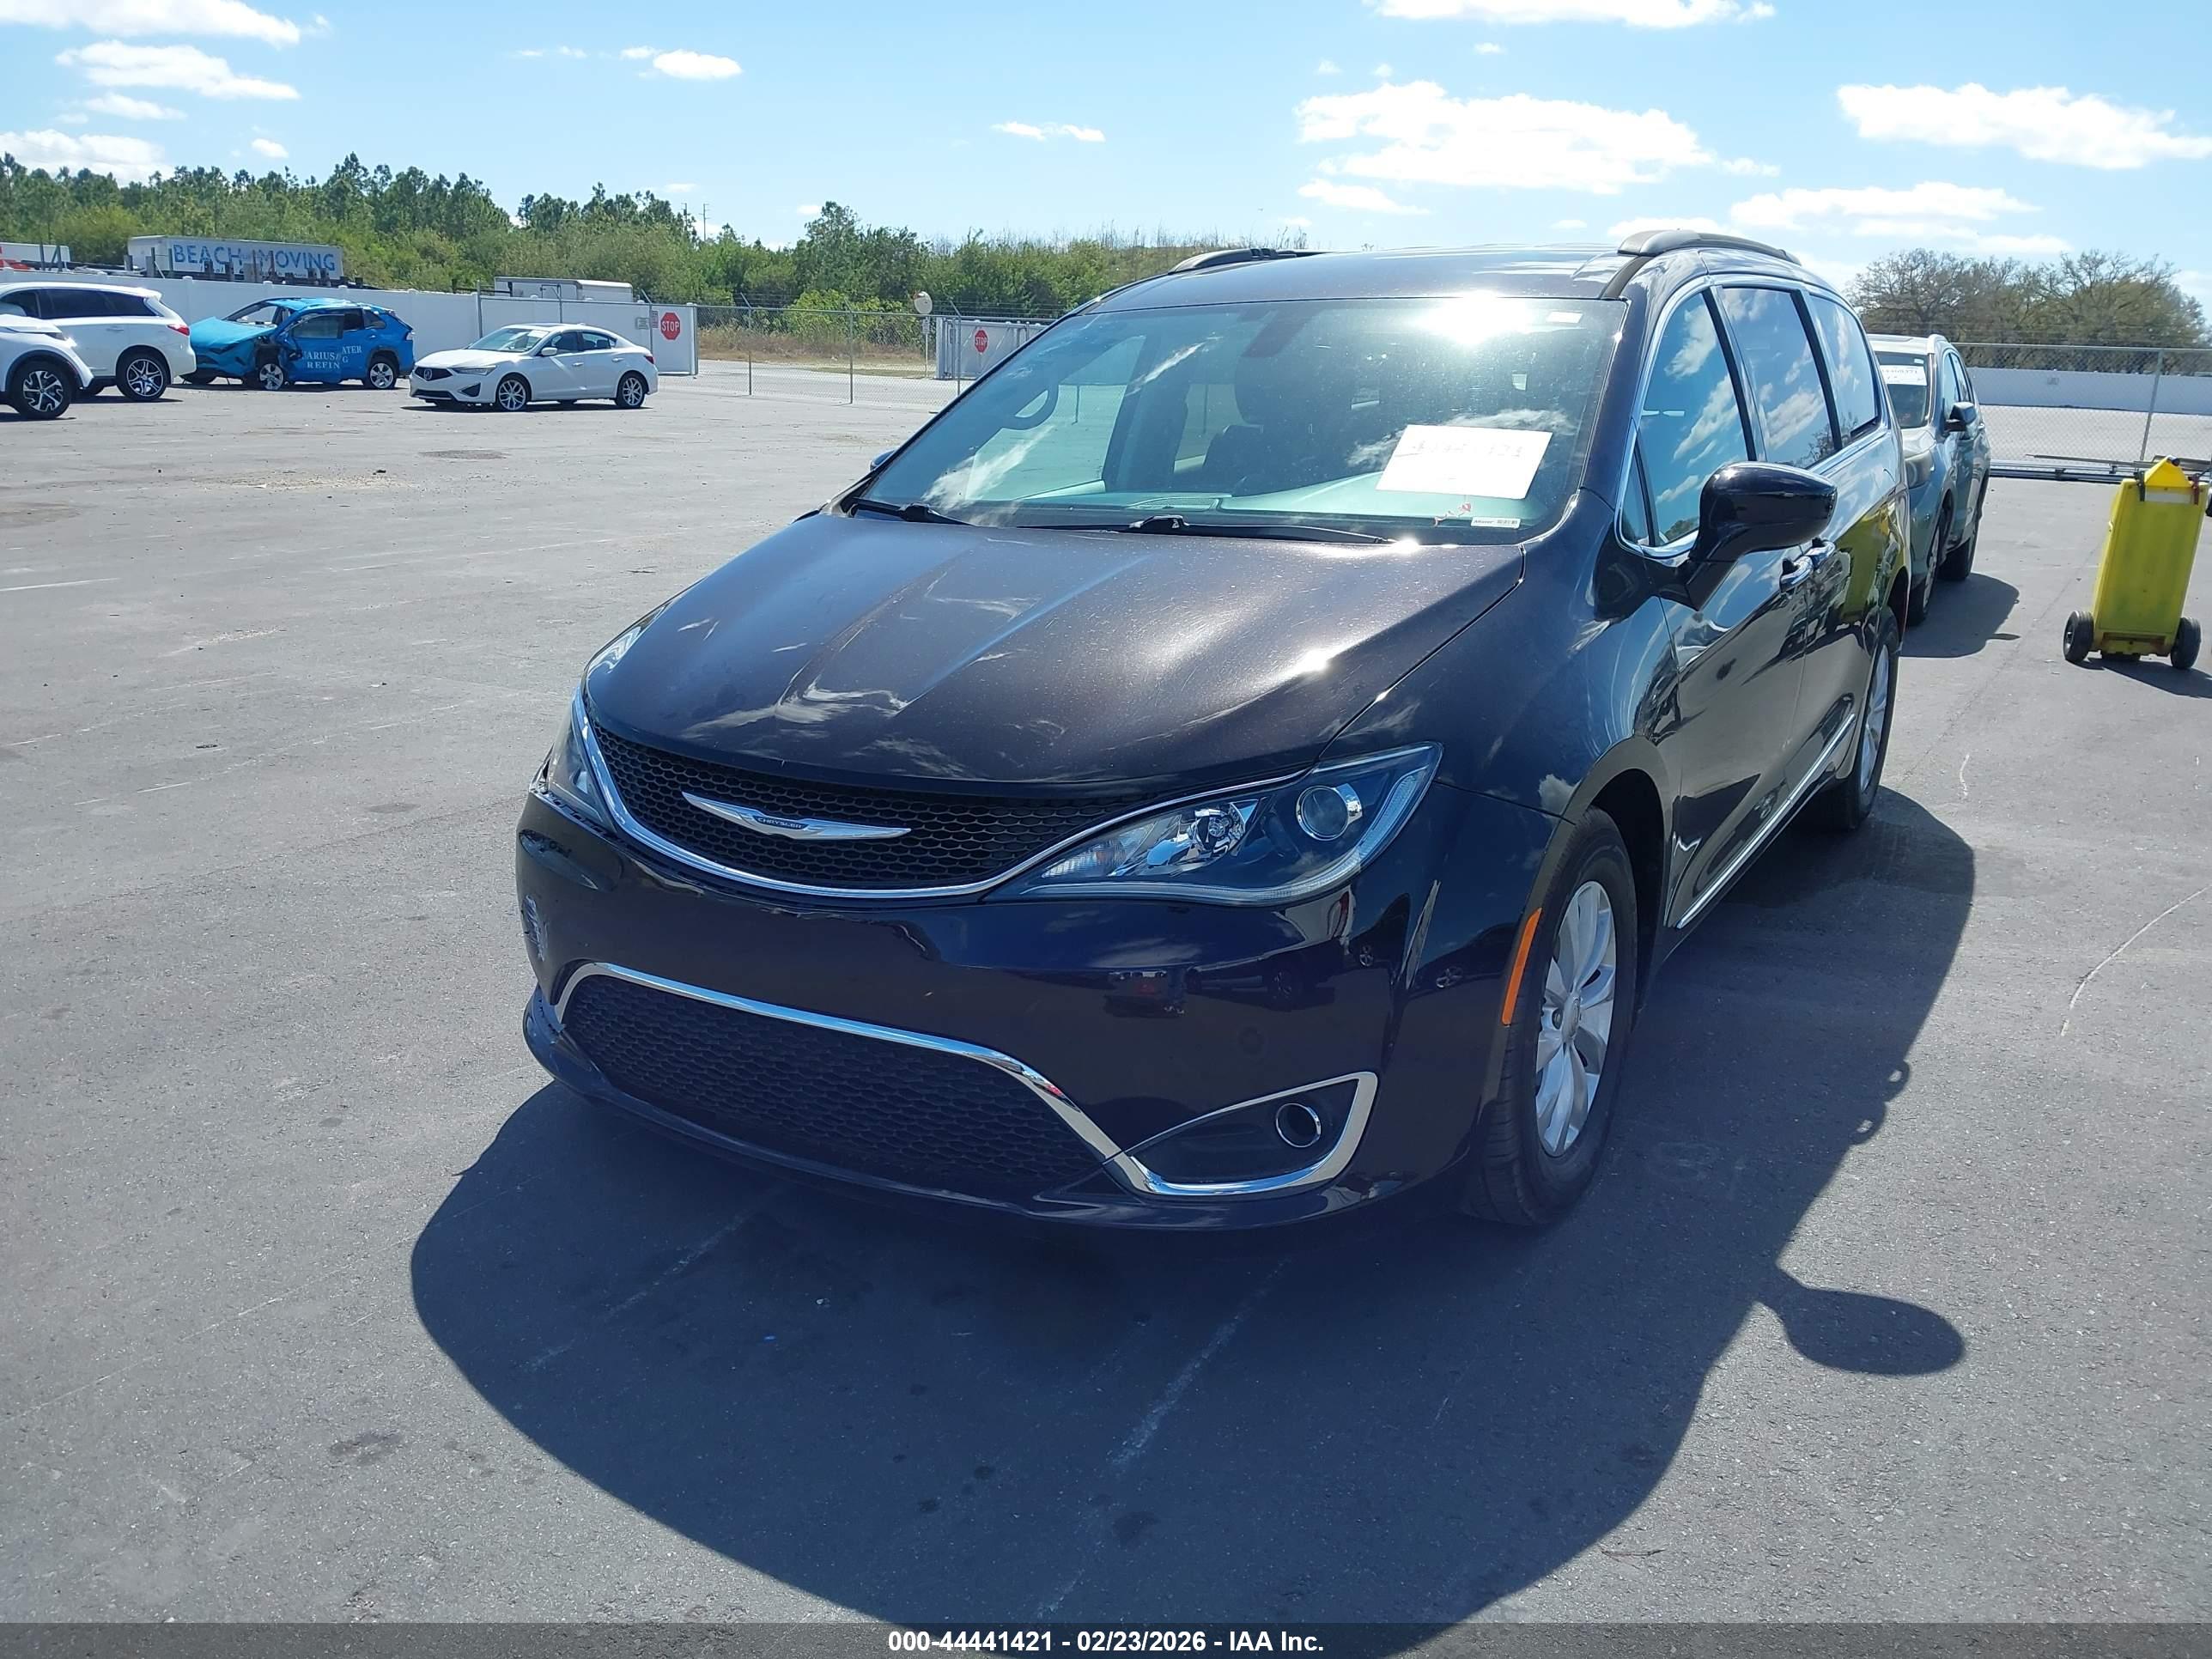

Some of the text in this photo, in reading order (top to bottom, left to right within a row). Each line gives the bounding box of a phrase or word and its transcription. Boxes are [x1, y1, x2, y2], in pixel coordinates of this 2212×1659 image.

[173, 244, 336, 271] BEACH MOVING
[661, 320, 680, 332] STOP
[975, 336, 988, 347] STOP
[757, 817, 802, 829] CHRYSLER
